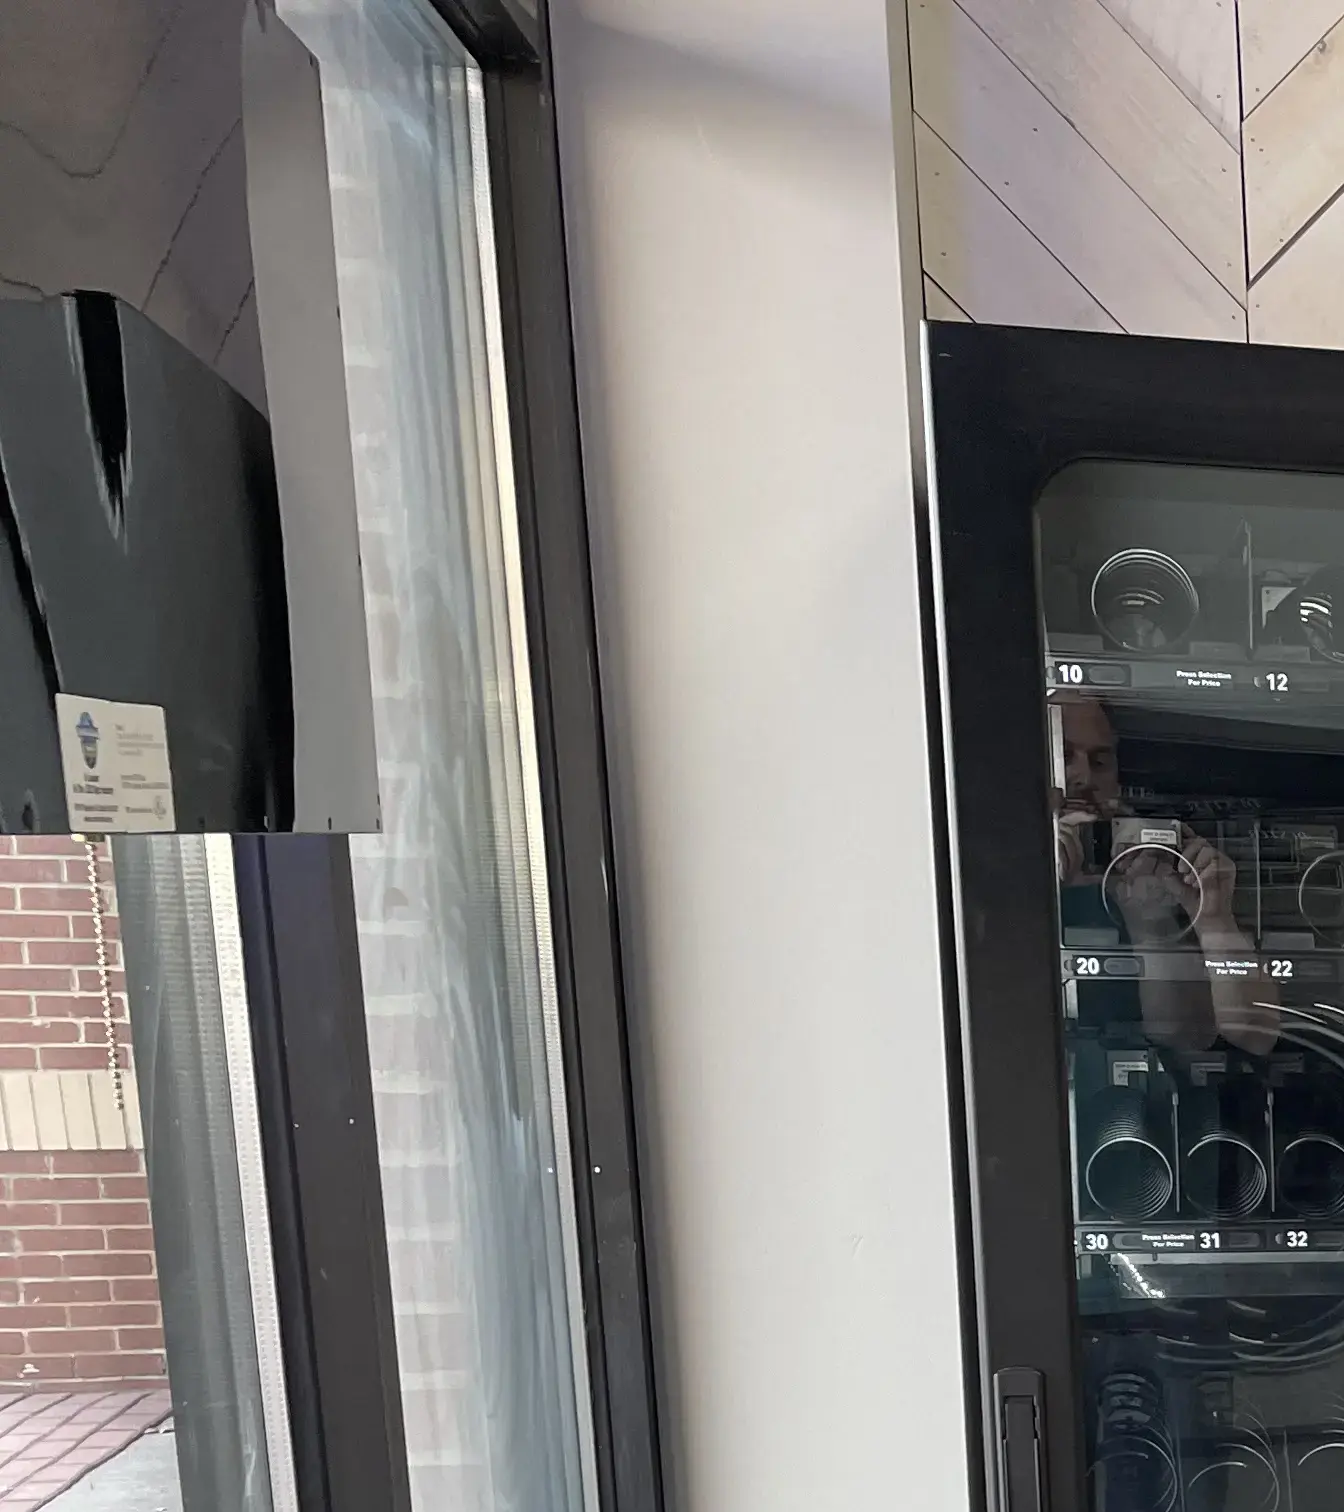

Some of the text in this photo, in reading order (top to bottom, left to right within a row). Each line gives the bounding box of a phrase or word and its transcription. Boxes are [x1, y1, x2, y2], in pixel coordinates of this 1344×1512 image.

[1058, 664, 1083, 684] 10
[1265, 673, 1288, 692] 12
[1076, 957, 1100, 975] 20
[1271, 960, 1293, 977] 22
[1085, 1233, 1109, 1251] 30
[1199, 1232, 1220, 1249] 31
[1286, 1230, 1308, 1248] 32
